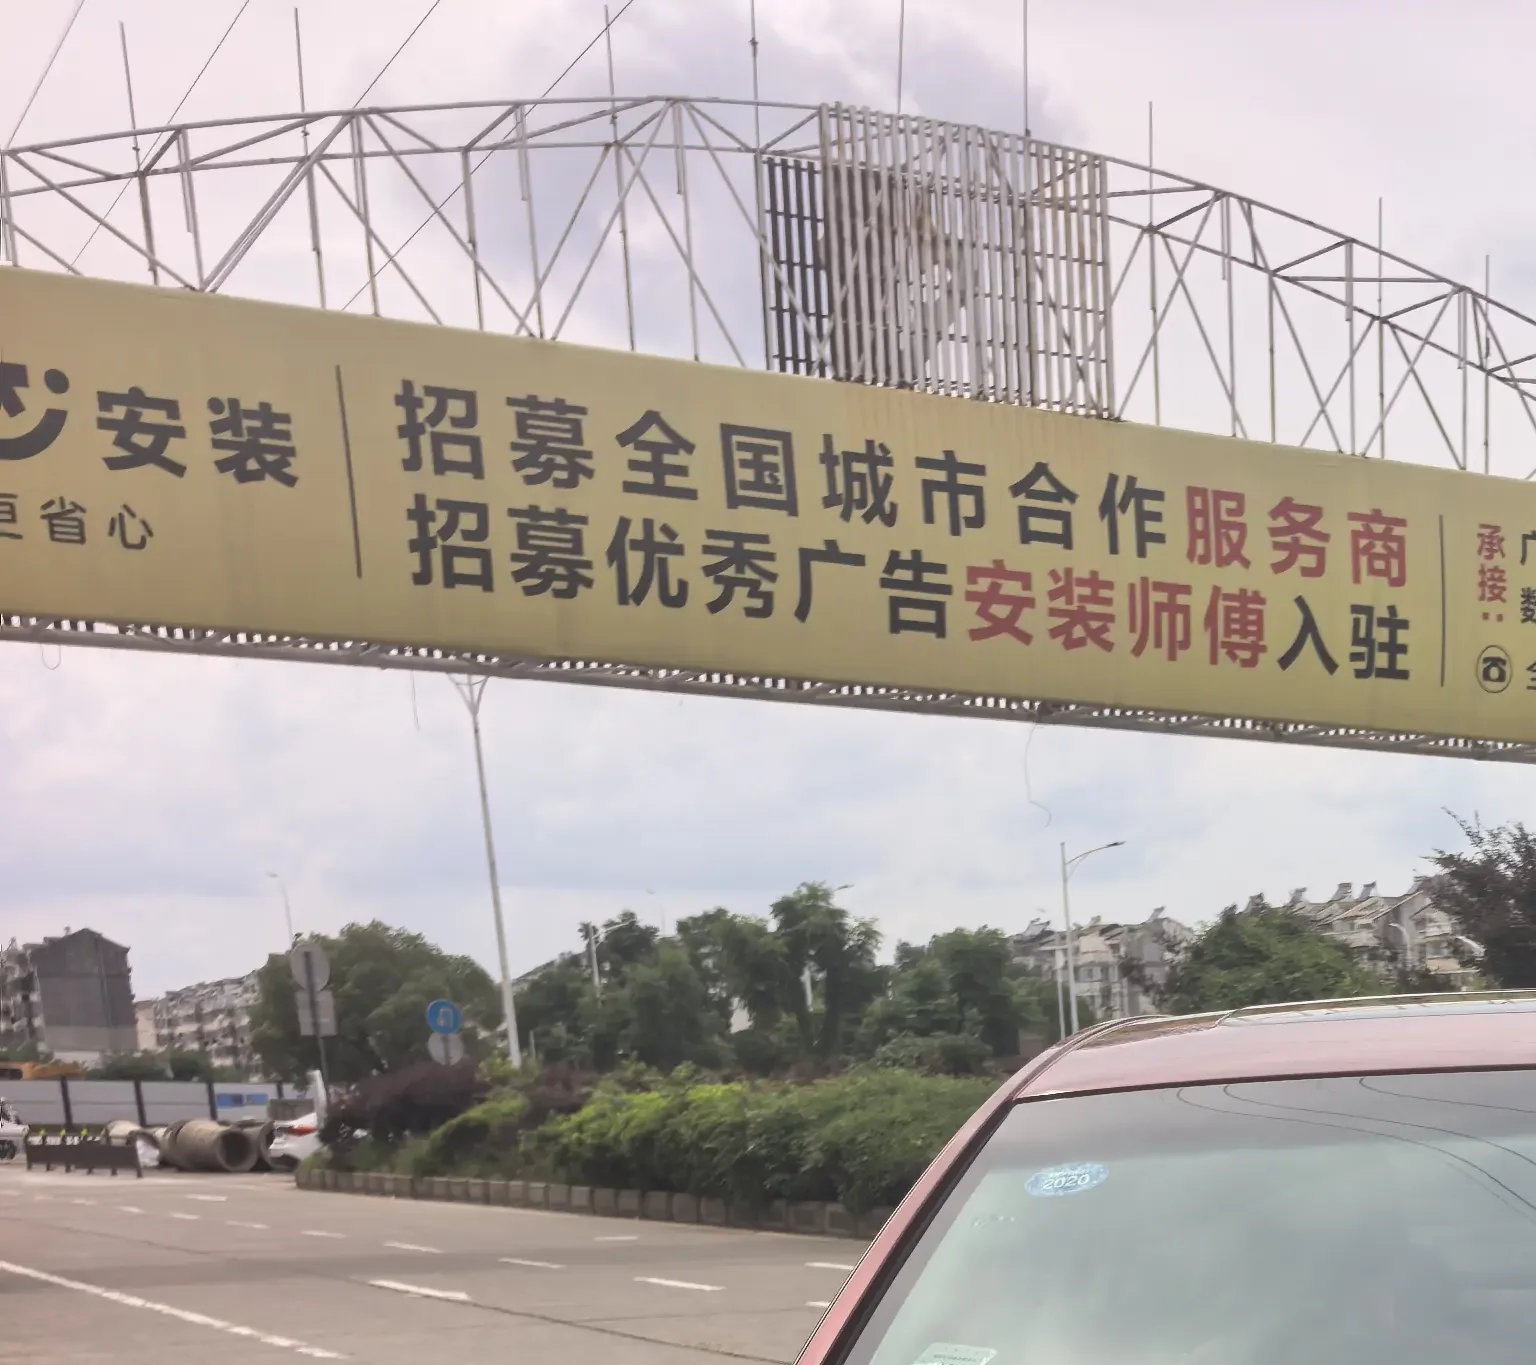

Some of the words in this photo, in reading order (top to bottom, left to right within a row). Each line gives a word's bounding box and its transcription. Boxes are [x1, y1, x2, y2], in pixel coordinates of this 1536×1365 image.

[97, 386, 298, 488] 安装
[395, 379, 1408, 588] 招募全国城市合作服务商
[407, 494, 1410, 681] 招募优秀广告安装师傅入驻
[1041, 1173, 1090, 1191] 2020
